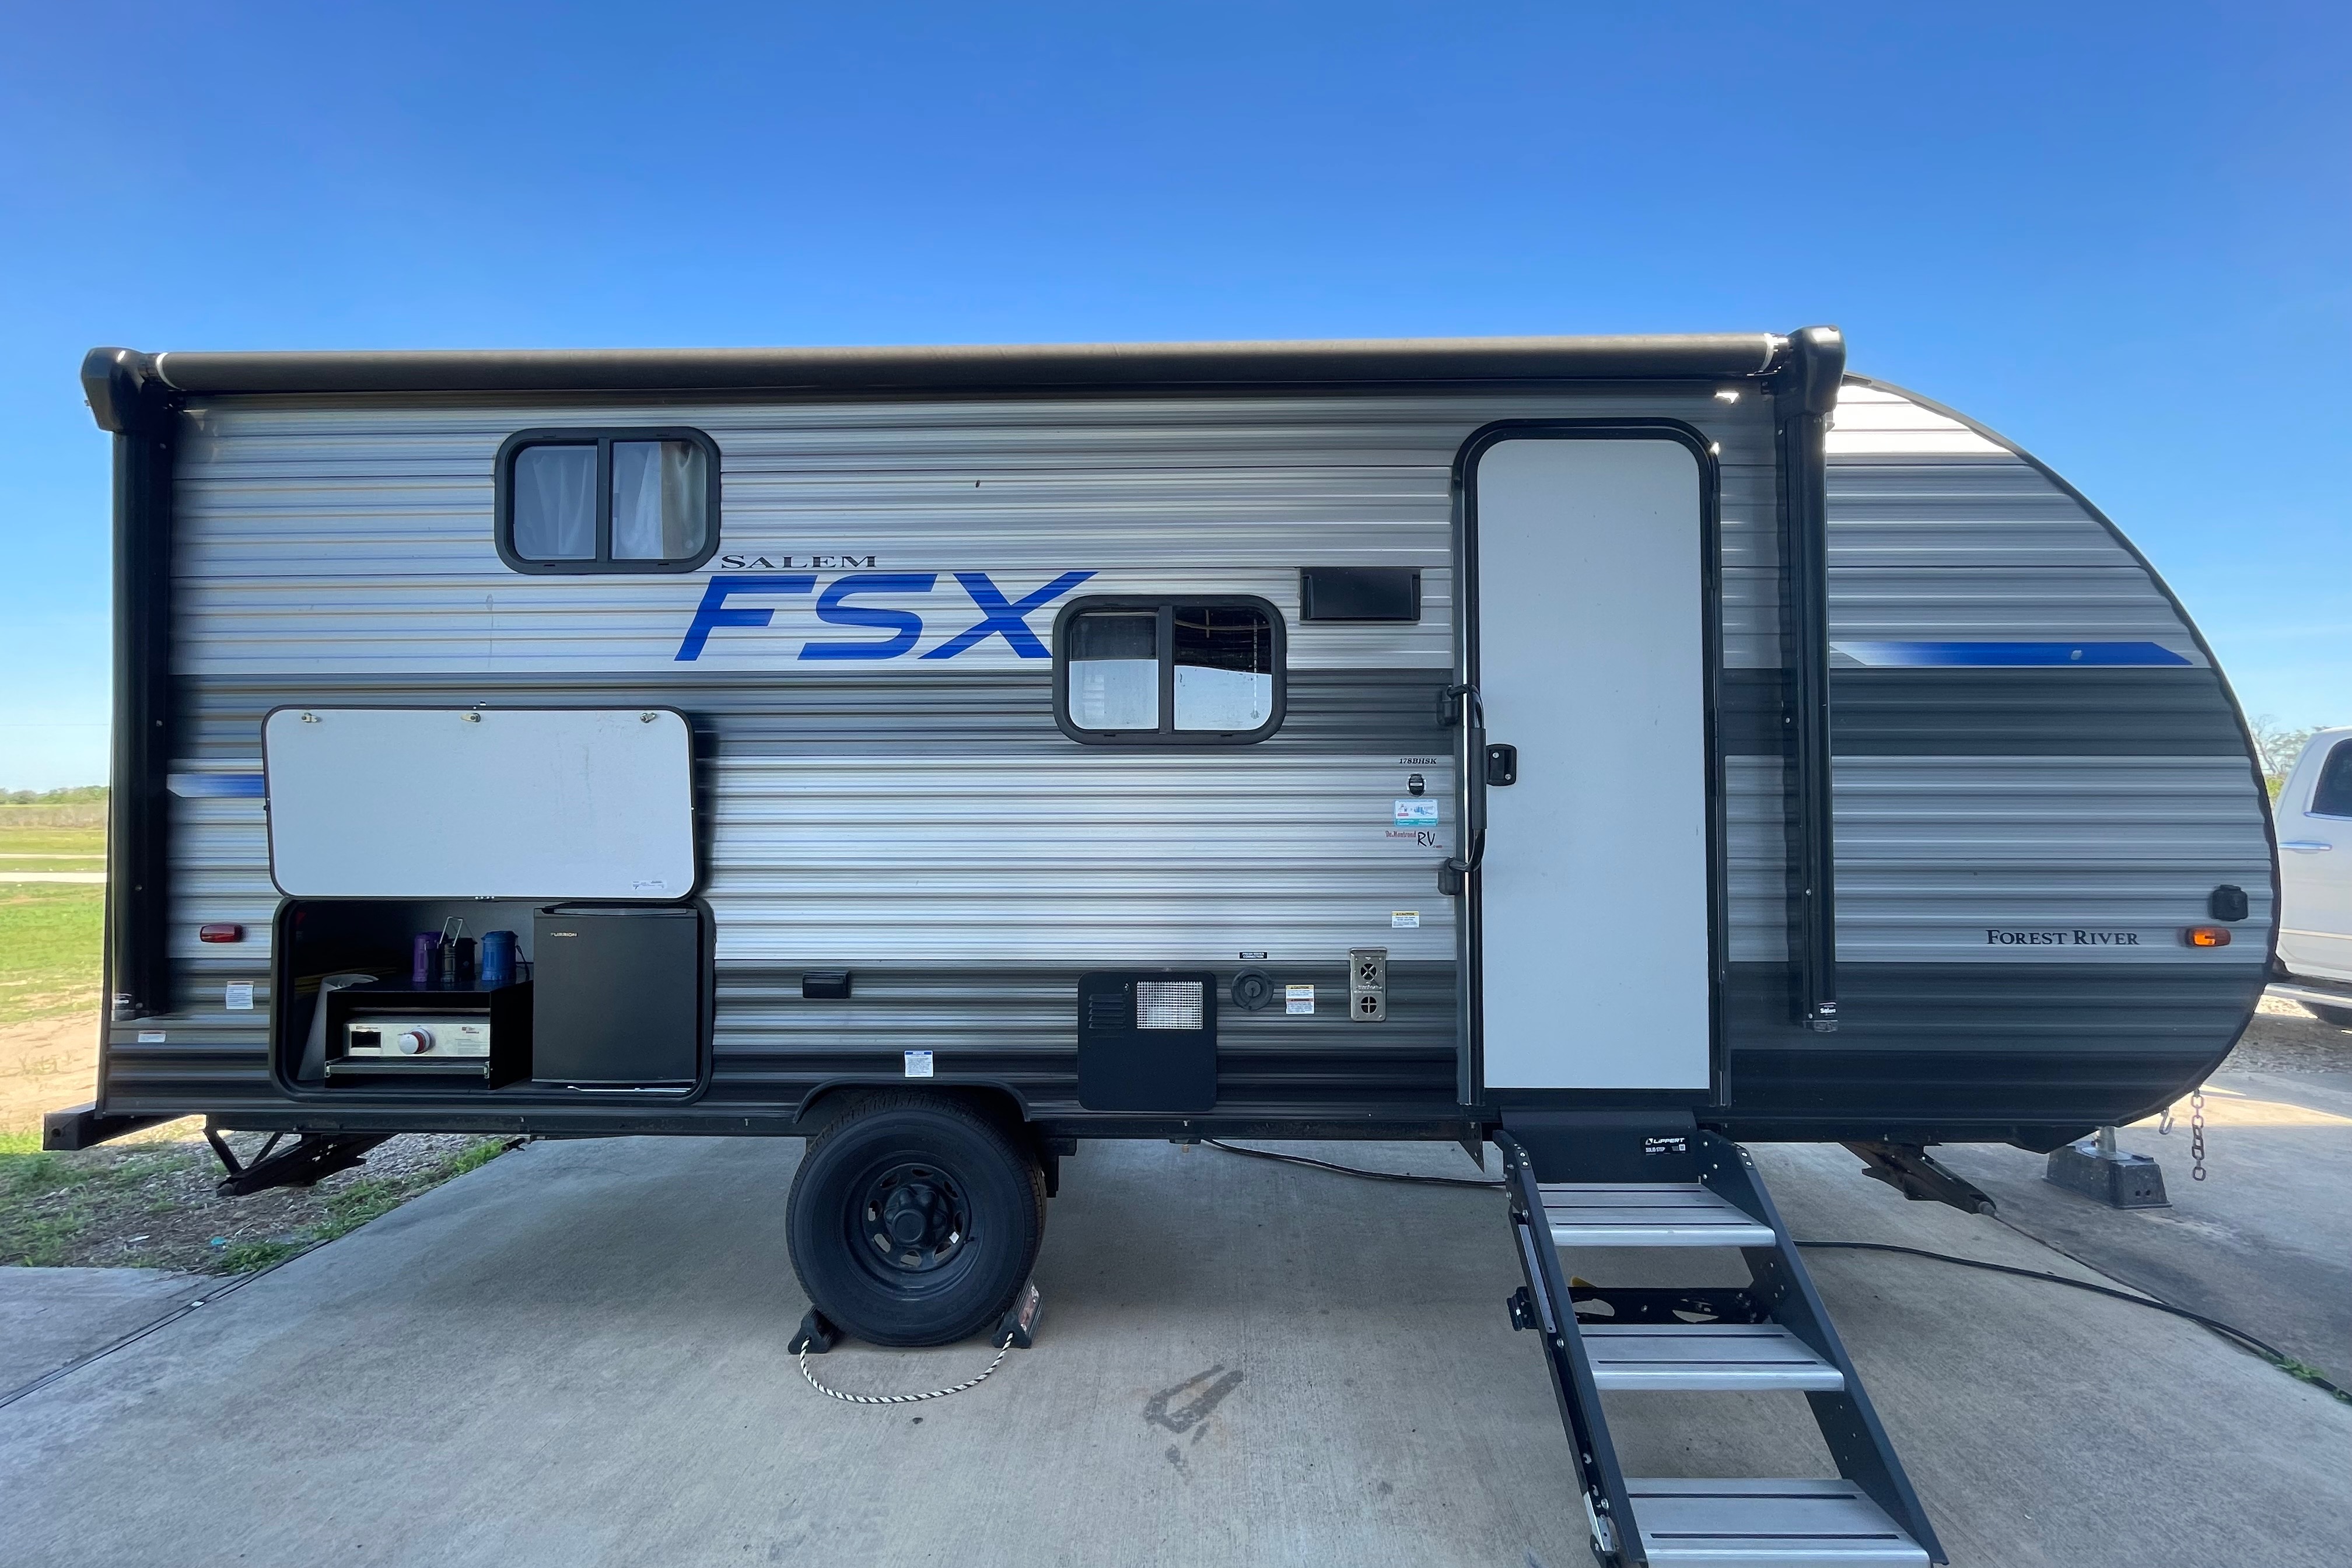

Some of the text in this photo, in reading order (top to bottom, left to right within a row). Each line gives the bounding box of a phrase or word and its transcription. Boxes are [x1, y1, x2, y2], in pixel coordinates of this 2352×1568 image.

[721, 555, 877, 568] SALEM
[674, 571, 1100, 662] FSX
[1418, 831, 1436, 847] RV
[1986, 929, 2141, 945] FOREST RIVER
